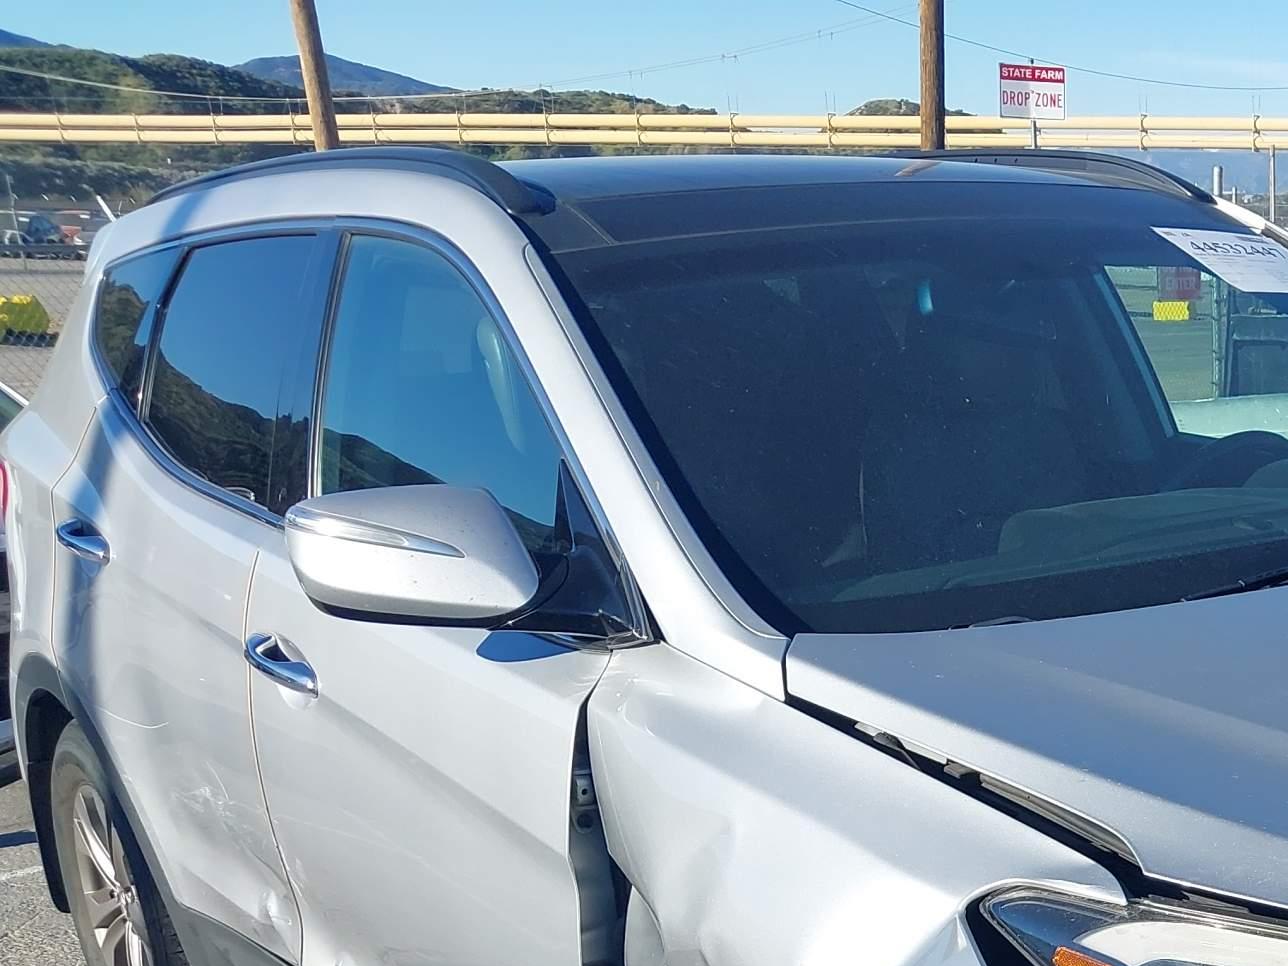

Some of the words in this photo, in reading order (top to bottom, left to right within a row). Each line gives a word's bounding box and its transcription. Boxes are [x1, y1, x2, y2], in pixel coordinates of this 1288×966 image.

[1001, 67, 1033, 79] STATE
[1034, 69, 1063, 80] FARM
[1002, 90, 1031, 107] DROP
[1034, 92, 1063, 108] ZONE
[1190, 241, 1287, 259] 44532447
